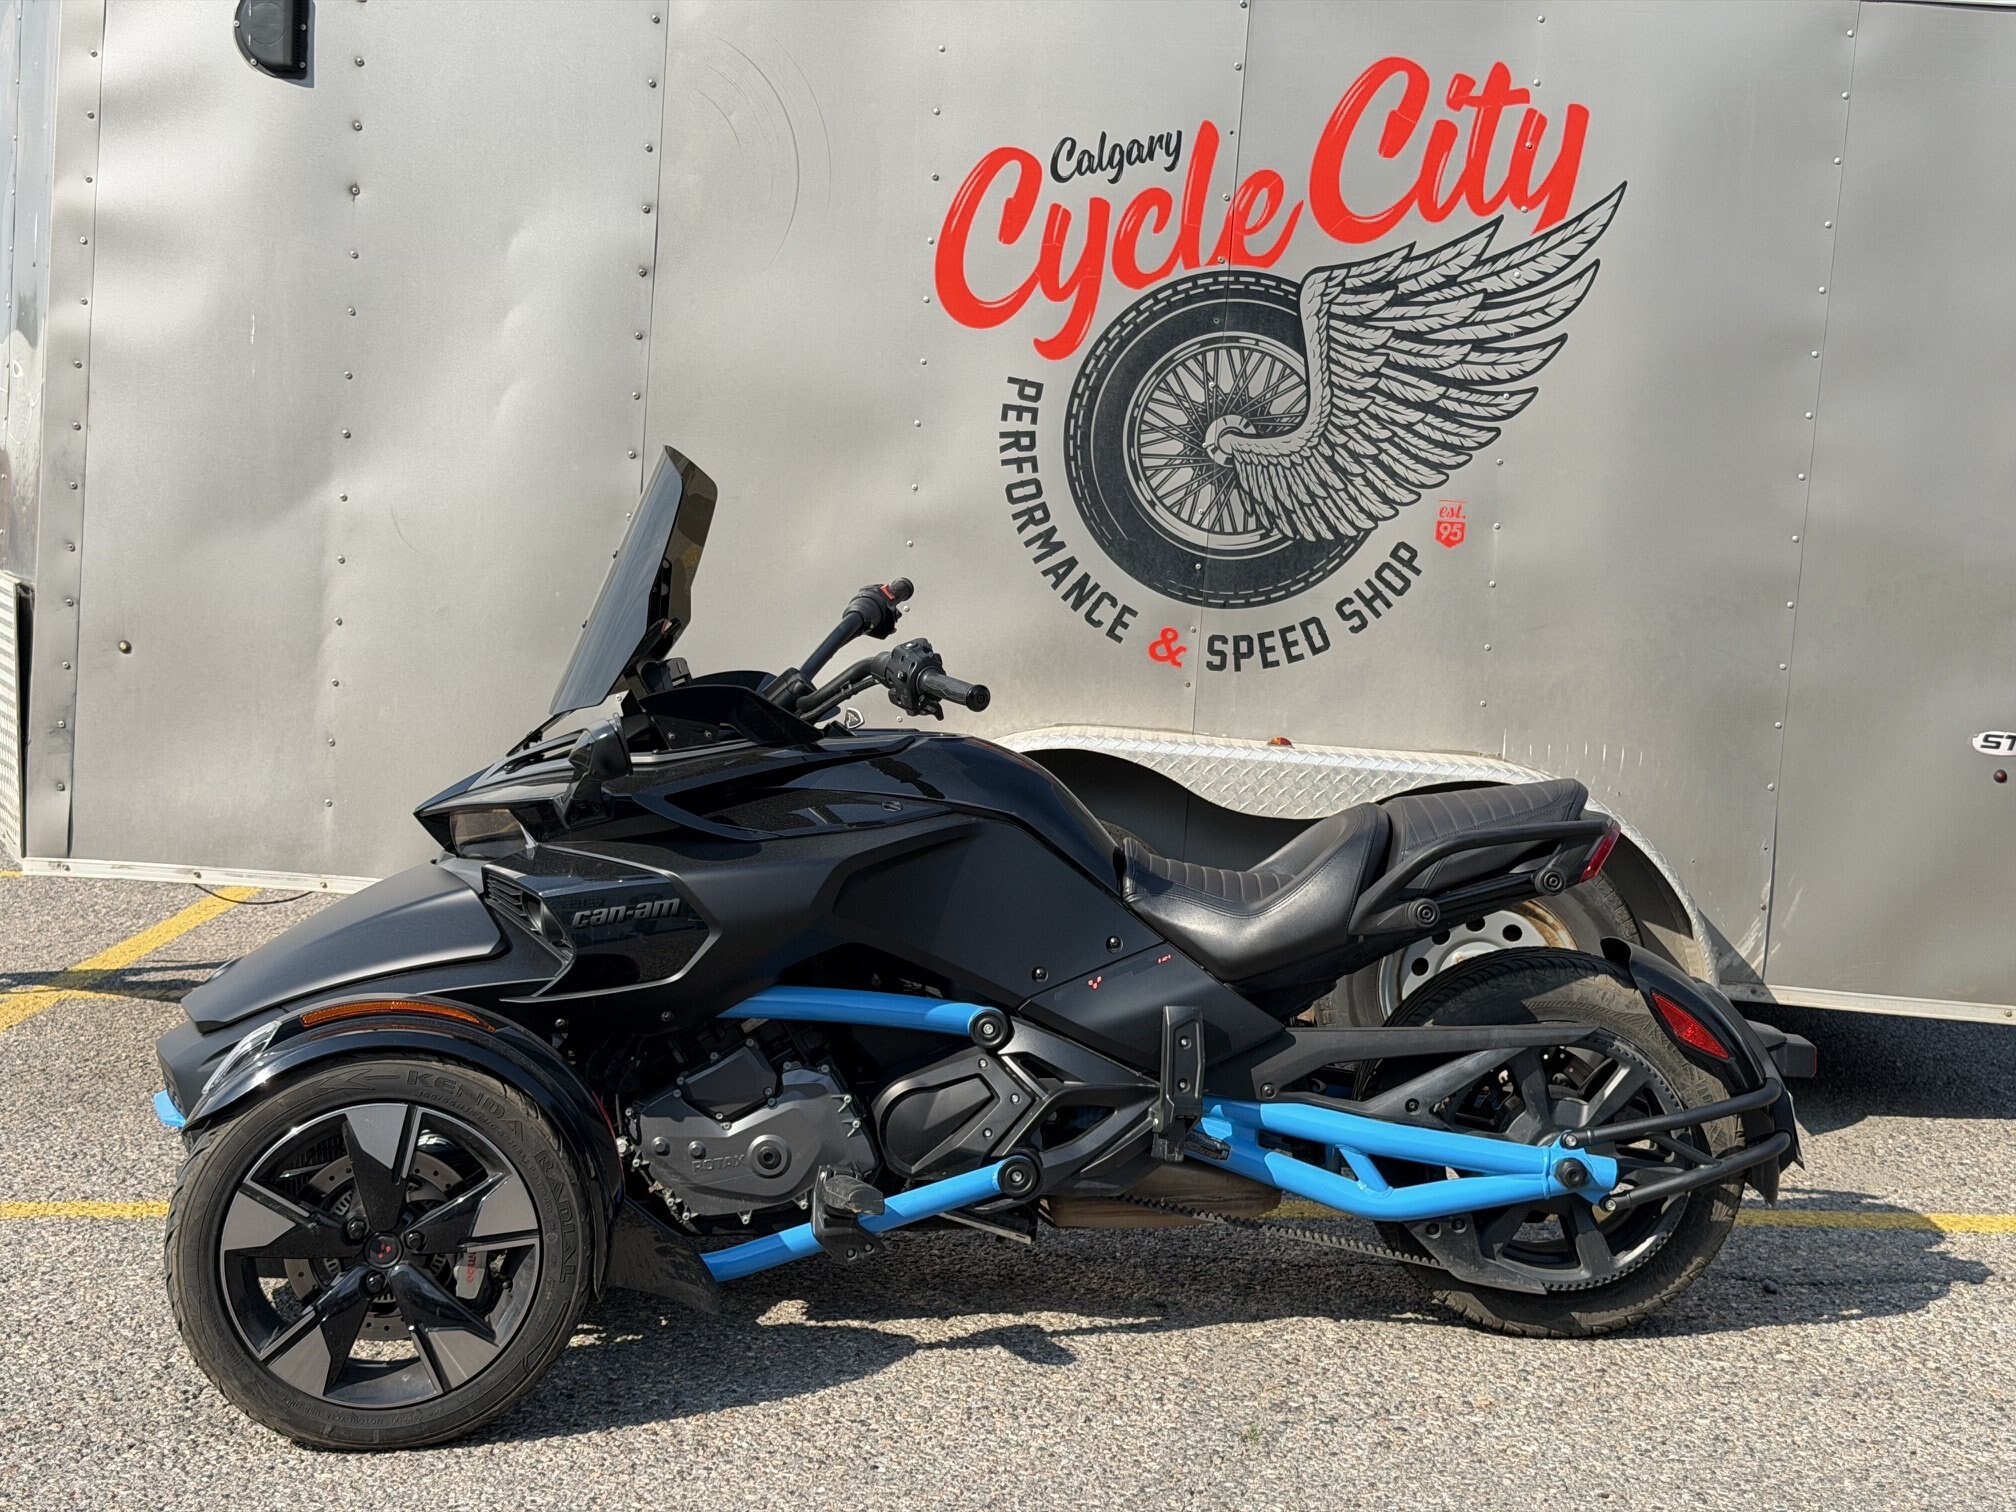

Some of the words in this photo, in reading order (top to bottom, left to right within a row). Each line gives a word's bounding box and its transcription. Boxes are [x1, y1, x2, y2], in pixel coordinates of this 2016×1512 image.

[1051, 130, 1184, 184] Calgary
[934, 120, 1304, 361] Cycle
[1308, 56, 1590, 244] City
[1000, 377, 1138, 643] PERFORMANCE
[1148, 626, 1187, 668] &
[1206, 617, 1330, 672] SPEED
[1335, 542, 1422, 633] SHOP
[1440, 523, 1462, 541] 95
[573, 898, 681, 929] can-am
[691, 1154, 746, 1173] ROTAX
[534, 1149, 577, 1284] RADIAL
